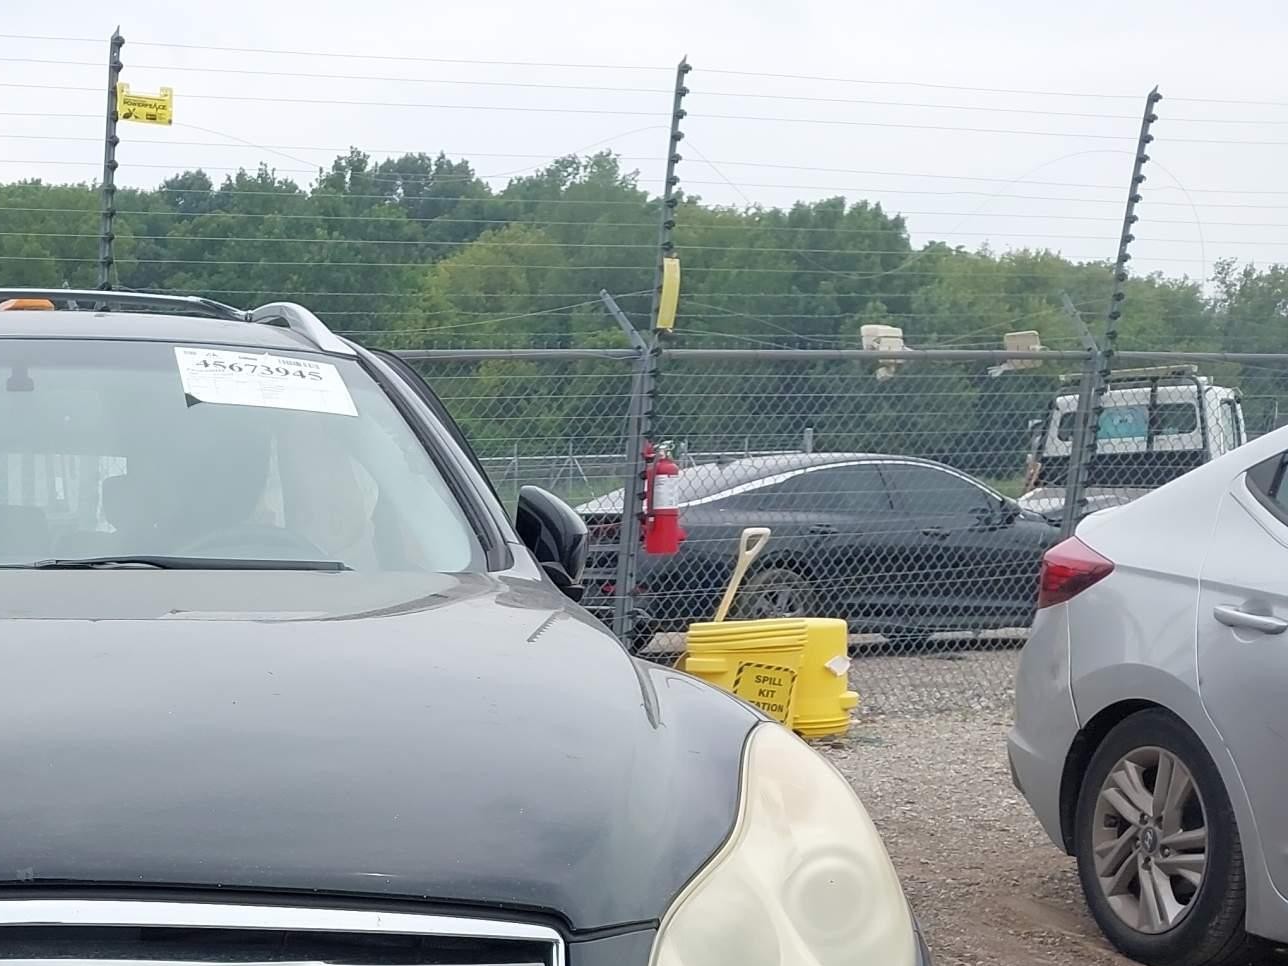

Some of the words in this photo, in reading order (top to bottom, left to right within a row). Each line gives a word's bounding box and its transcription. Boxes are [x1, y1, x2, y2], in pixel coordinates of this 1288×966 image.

[195, 359, 323, 381] 45673945
[754, 674, 783, 687] SPILL
[758, 688, 777, 698] KIT
[748, 699, 785, 712] ATION
